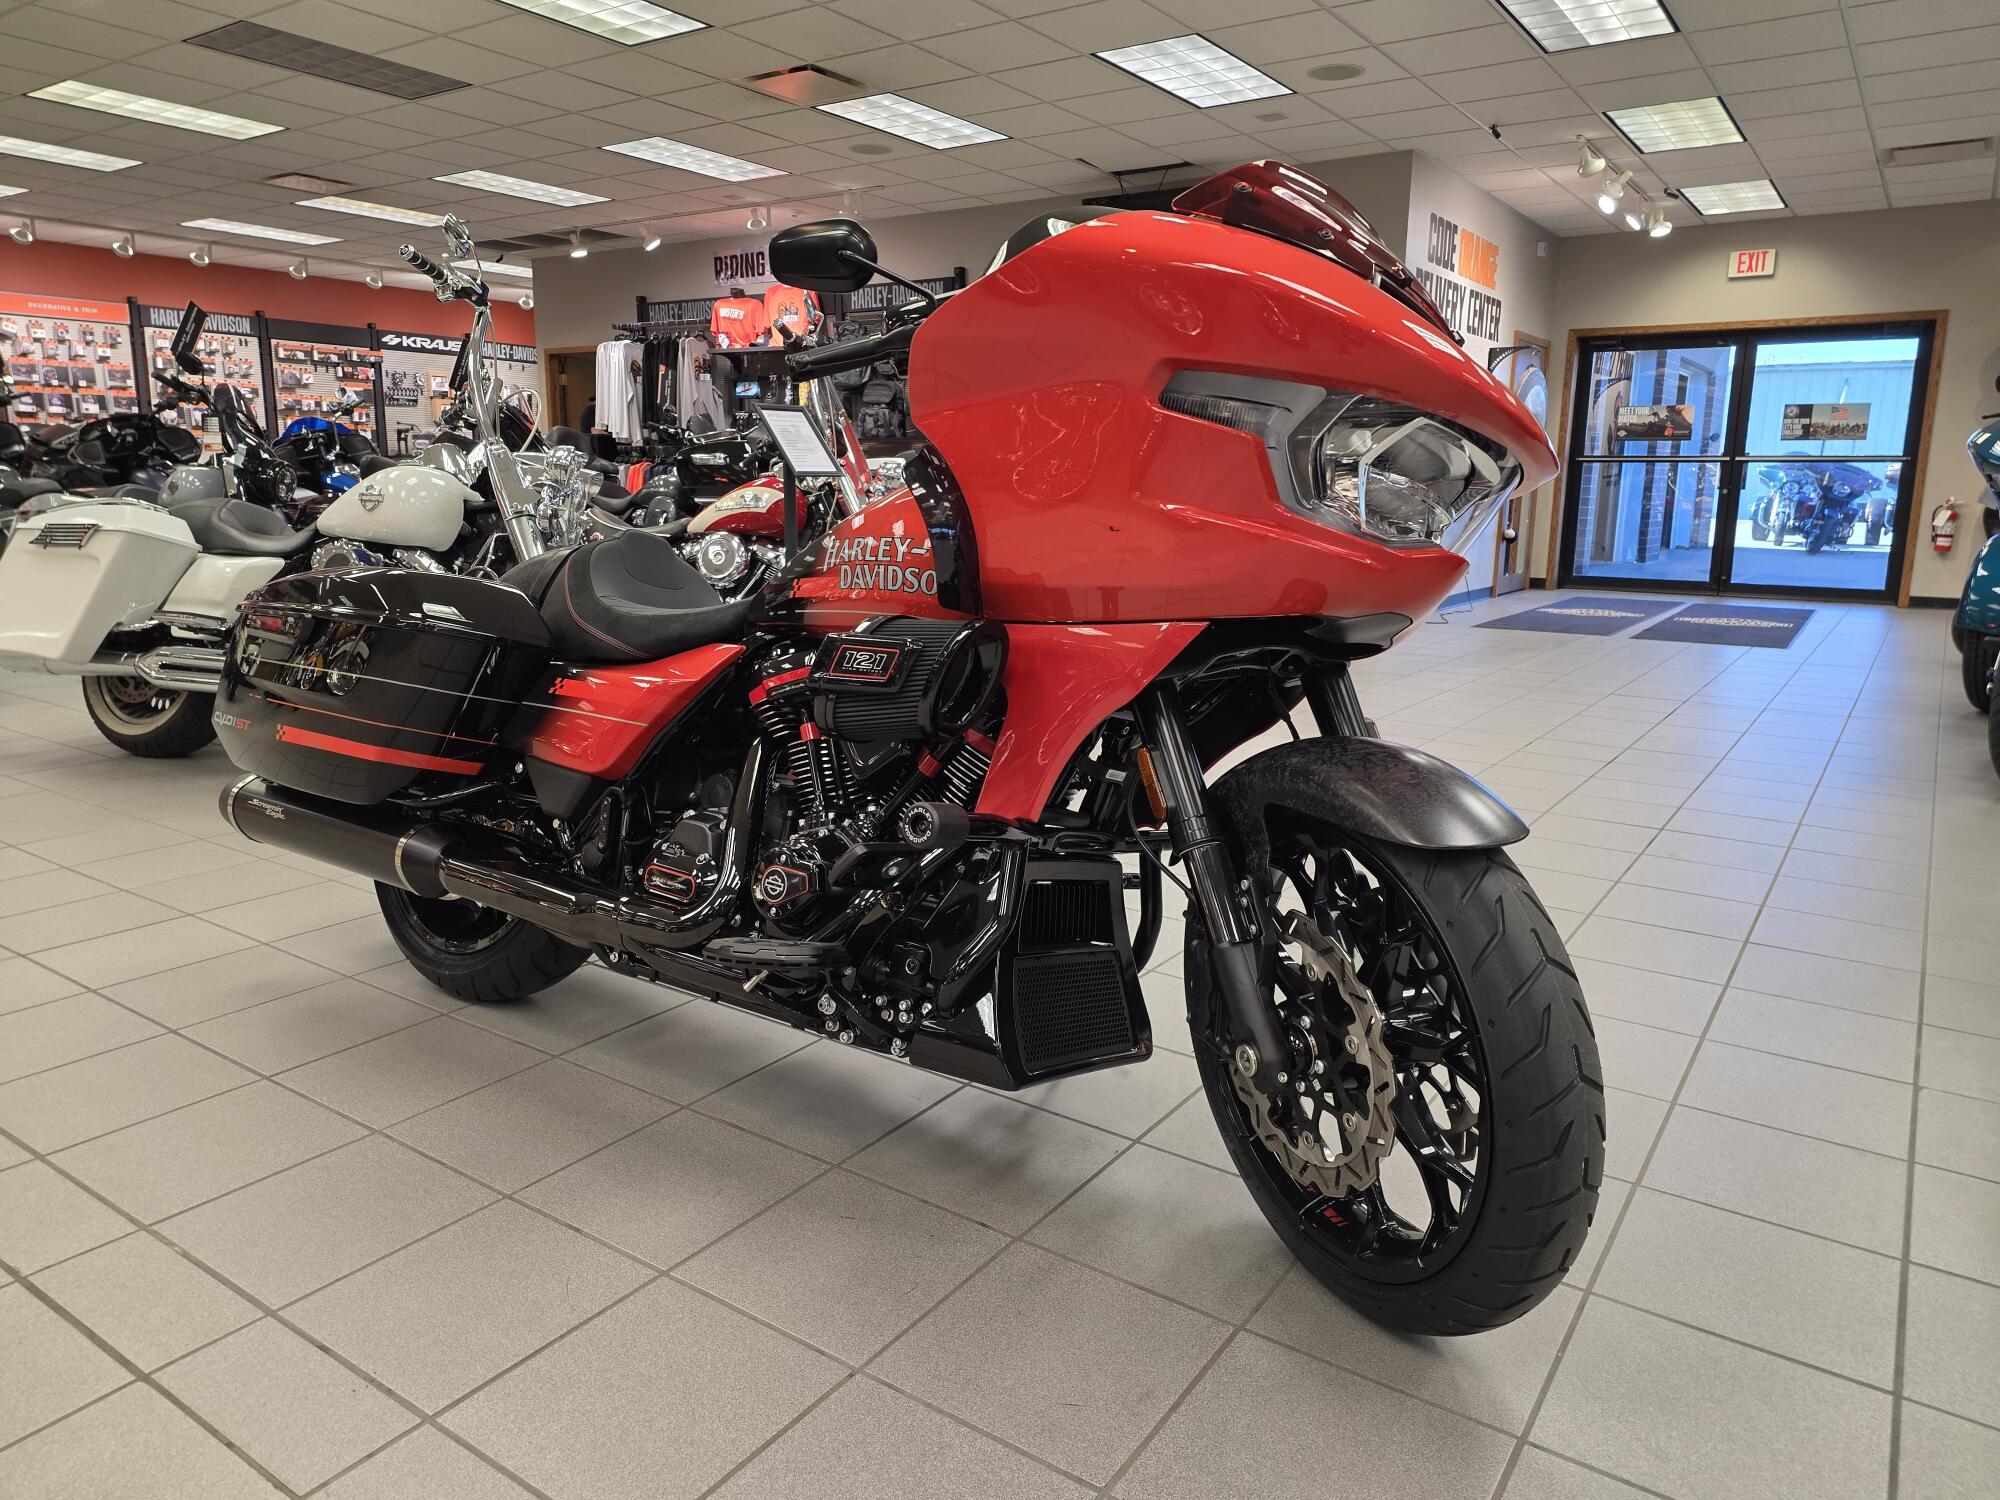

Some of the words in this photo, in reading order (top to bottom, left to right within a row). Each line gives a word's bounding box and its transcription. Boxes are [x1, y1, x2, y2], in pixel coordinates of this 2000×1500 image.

[1427, 212, 1459, 272] CODE
[714, 250, 766, 282] RIDING
[1737, 250, 1769, 273] EXIT
[27, 302, 73, 312] DECORATIVE
[81, 306, 98, 314] TRIM
[1466, 289, 1502, 343] CENTER
[402, 335, 463, 352] KRAUS
[843, 650, 888, 670] 121
